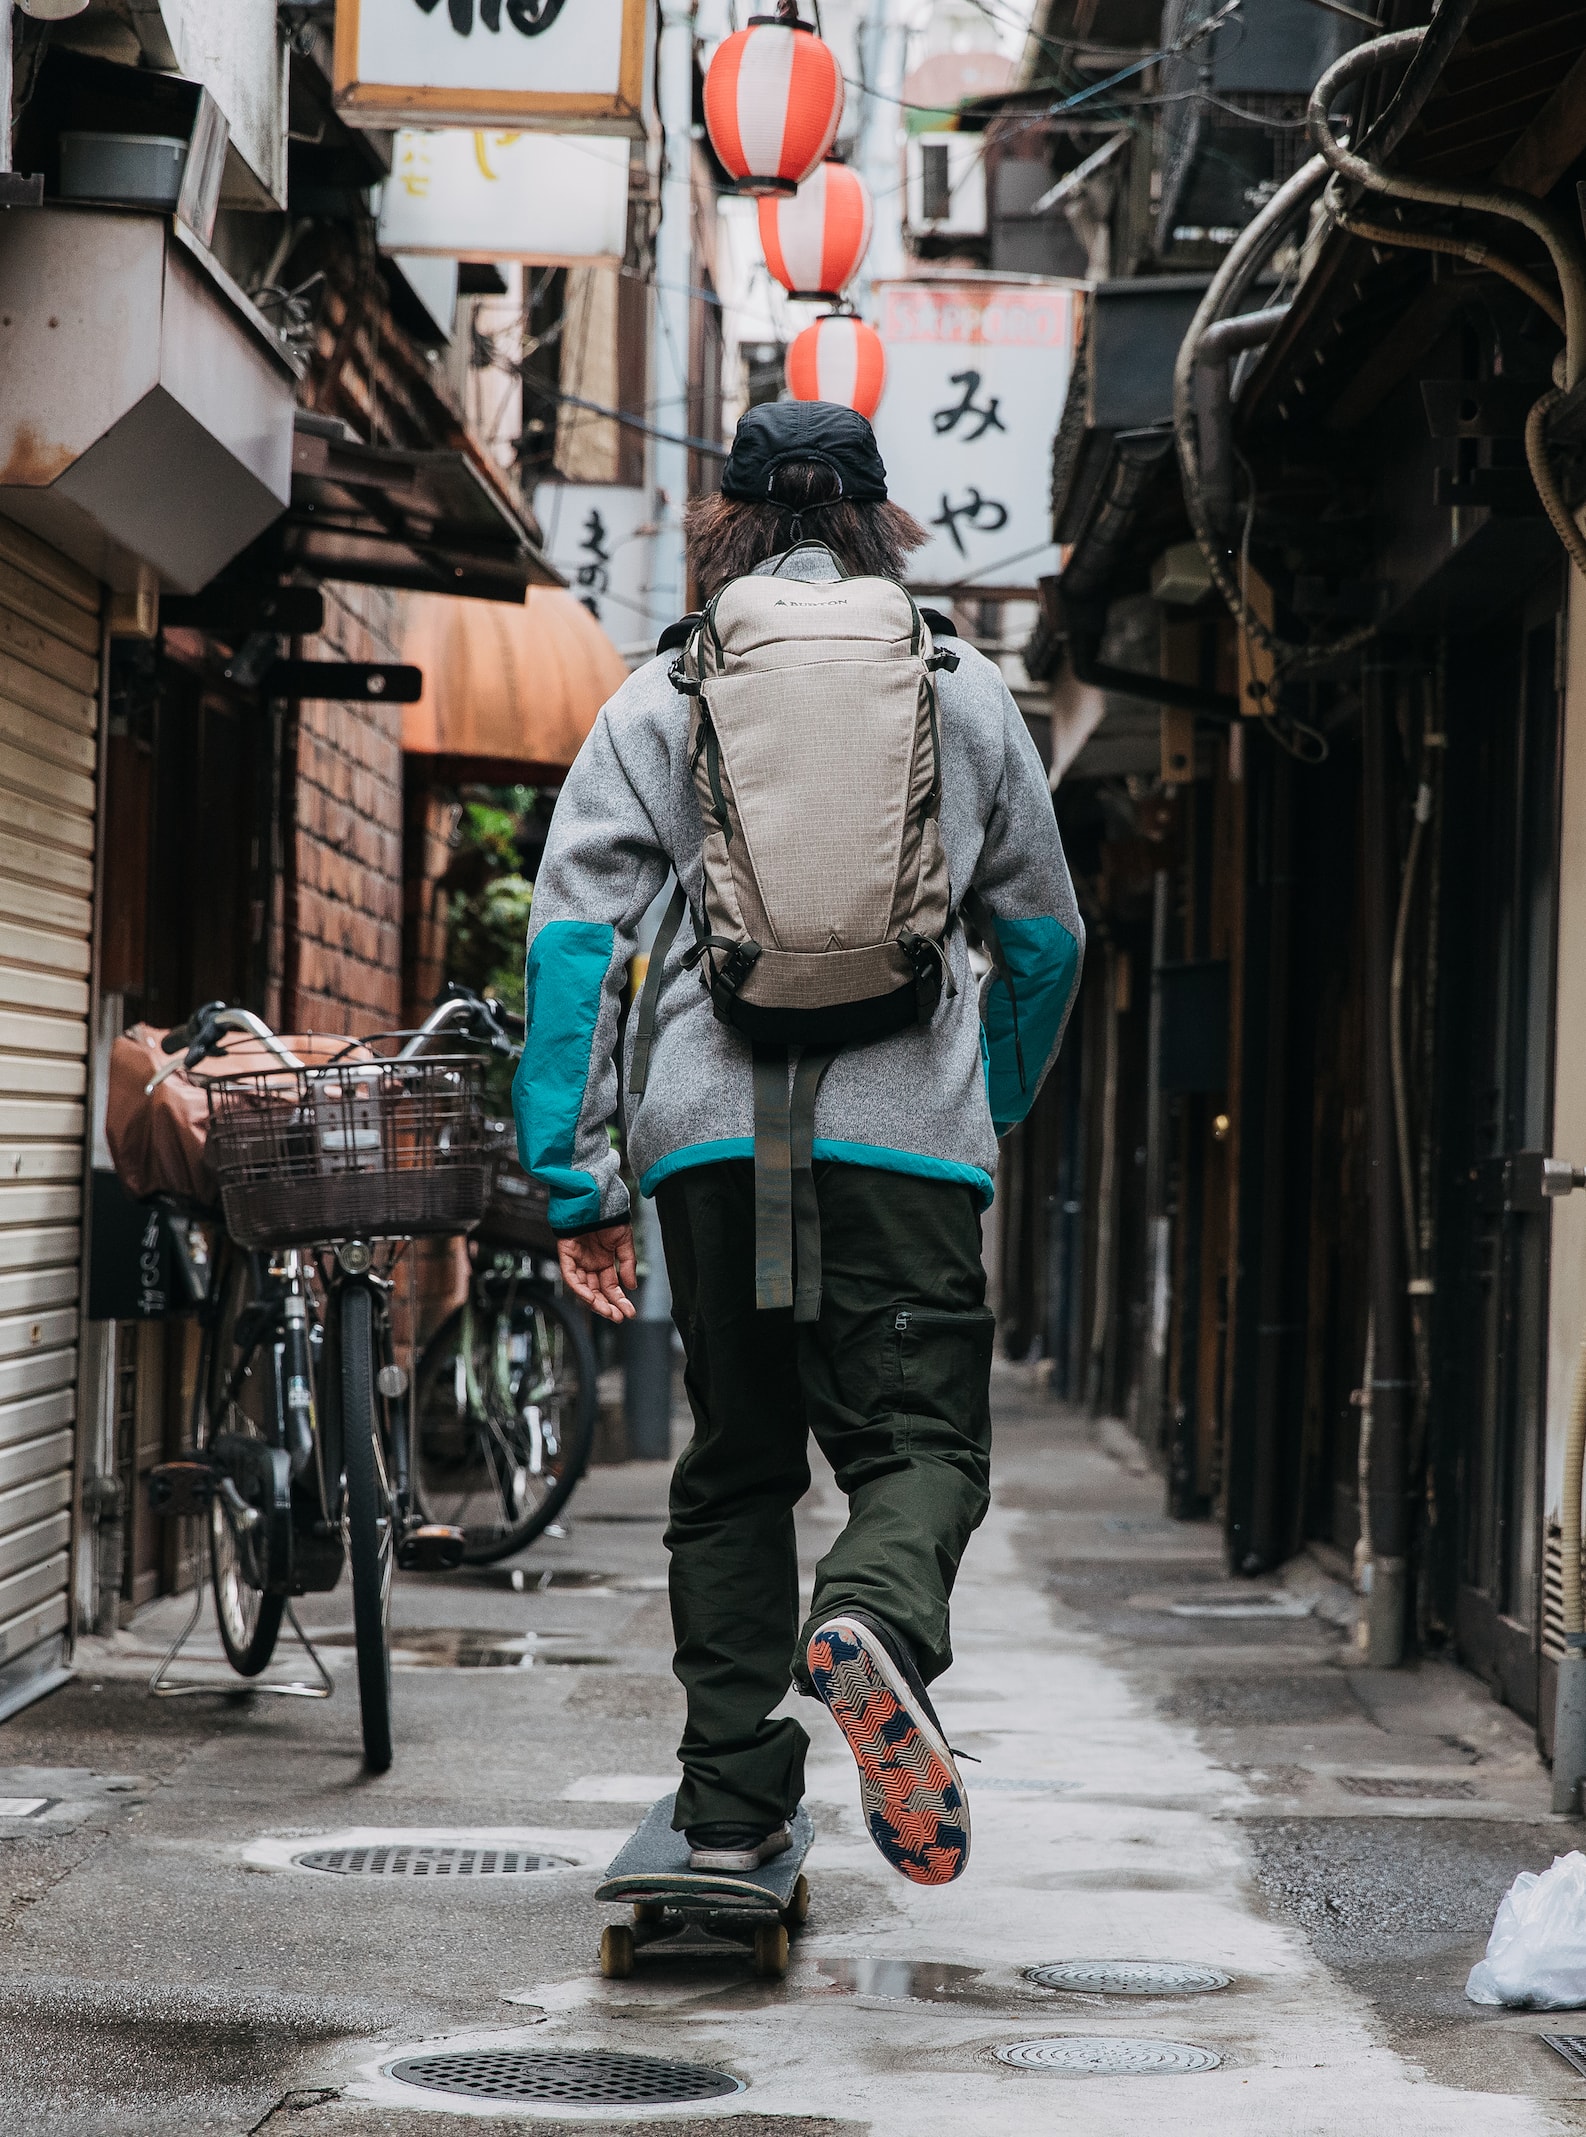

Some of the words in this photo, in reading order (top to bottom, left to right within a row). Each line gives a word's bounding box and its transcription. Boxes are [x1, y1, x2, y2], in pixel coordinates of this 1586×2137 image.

[894, 299, 1057, 343] SAPPORO
[931, 370, 1008, 558] みや
[789, 599, 848, 607] BURTON
